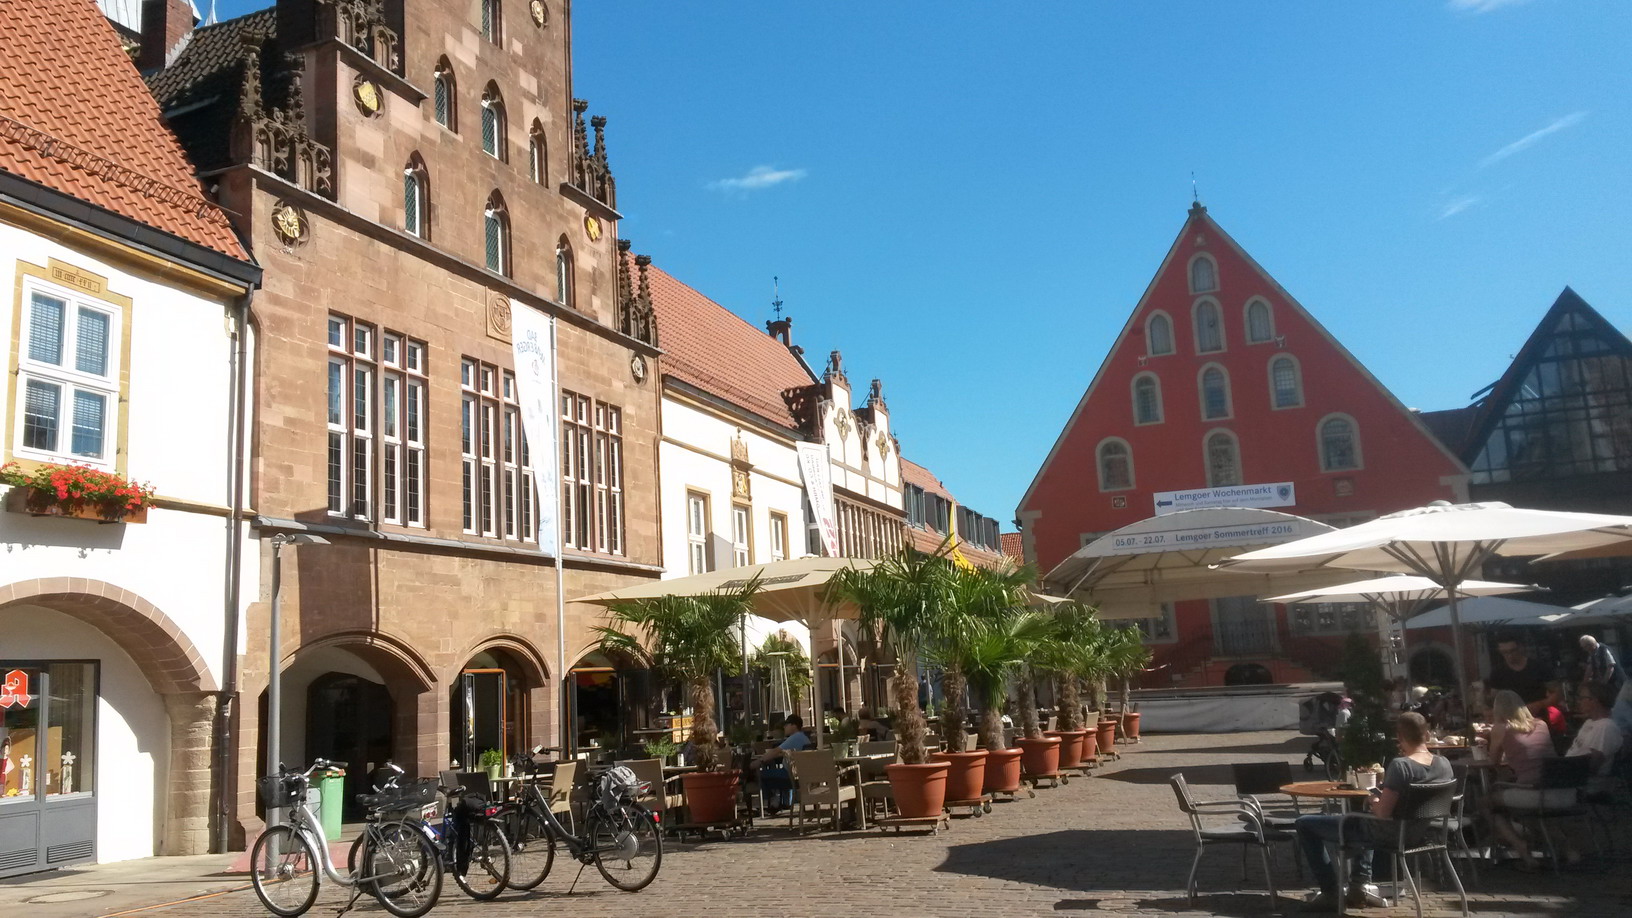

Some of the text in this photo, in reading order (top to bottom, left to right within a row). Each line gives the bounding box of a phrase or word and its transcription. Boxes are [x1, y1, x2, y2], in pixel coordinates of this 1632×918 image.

[1174, 492, 1210, 502] Lemgoer
[1212, 486, 1272, 498] Wochenmarkt
[1115, 537, 1138, 547] 05.07.
[1143, 535, 1166, 545] 22.07.
[1175, 532, 1212, 543] Lemgoer
[1214, 526, 1270, 538] Sommertreff
[1271, 525, 1293, 535] 2016
